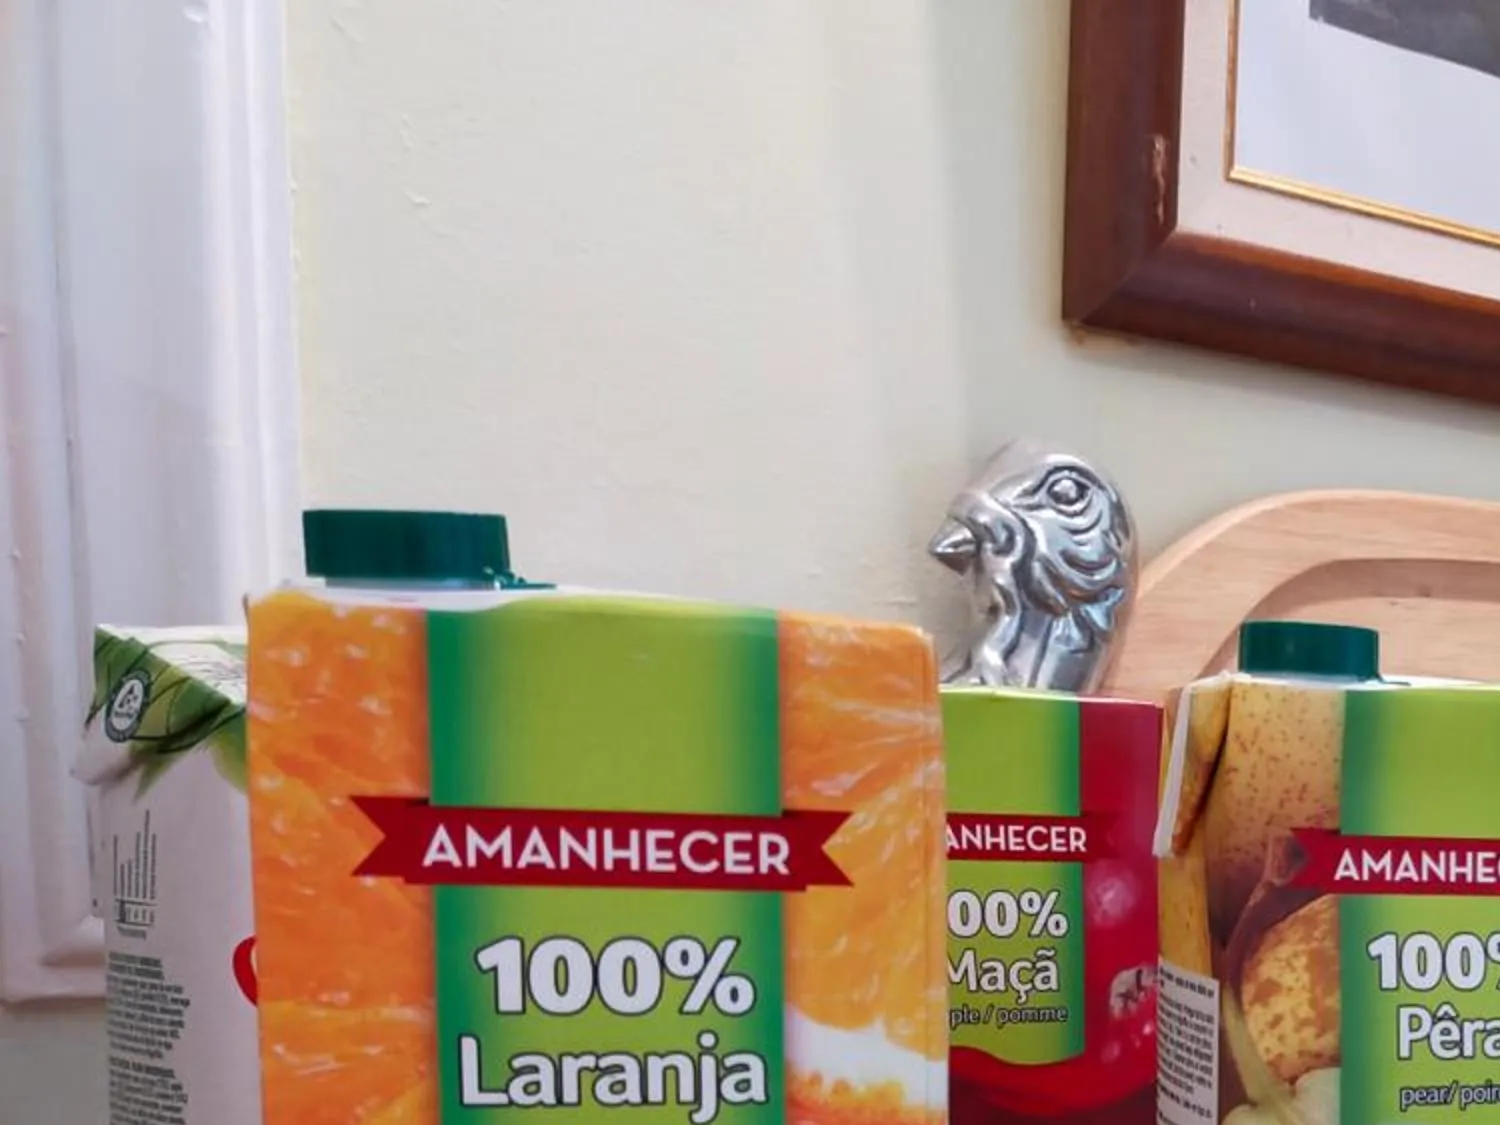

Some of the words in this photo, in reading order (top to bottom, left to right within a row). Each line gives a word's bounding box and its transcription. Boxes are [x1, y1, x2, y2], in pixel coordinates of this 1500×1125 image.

[422, 824, 791, 875] AMANHECER
[945, 824, 1087, 853] ANHECER
[946, 889, 1069, 938] 00%
[474, 935, 757, 1016] 100%
[947, 947, 1060, 1005] Maçã
[948, 1003, 980, 1031] ple
[996, 1007, 1069, 1029] pomme
[457, 1030, 769, 1125] Laranja
